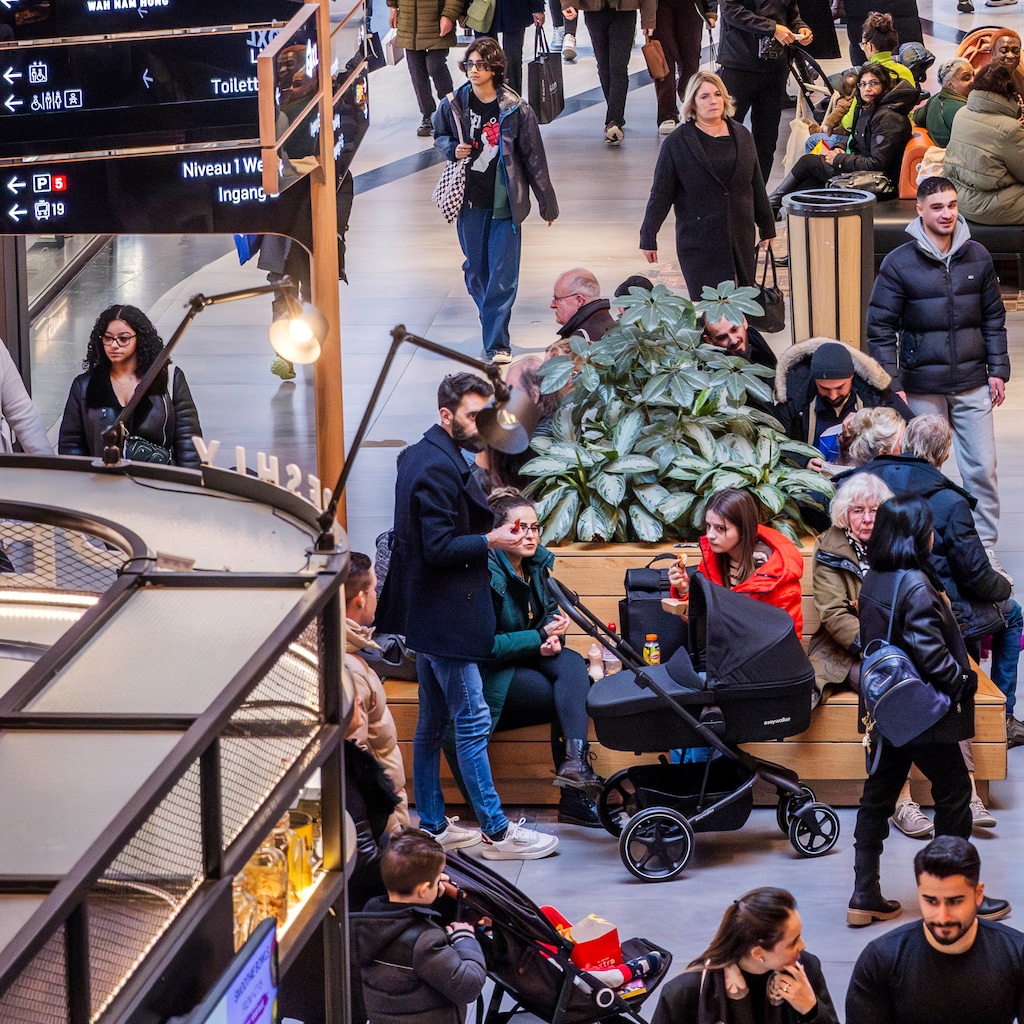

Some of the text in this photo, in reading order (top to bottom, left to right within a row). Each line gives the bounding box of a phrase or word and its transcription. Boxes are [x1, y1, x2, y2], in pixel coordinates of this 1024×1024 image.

[87, 0, 111, 13] WAH
[183, 159, 232, 178] Niveau
[235, 159, 240, 173] 1
[37, 177, 64, 190] P 5
[218, 185, 267, 204] Ingang
[51, 202, 65, 216] 19
